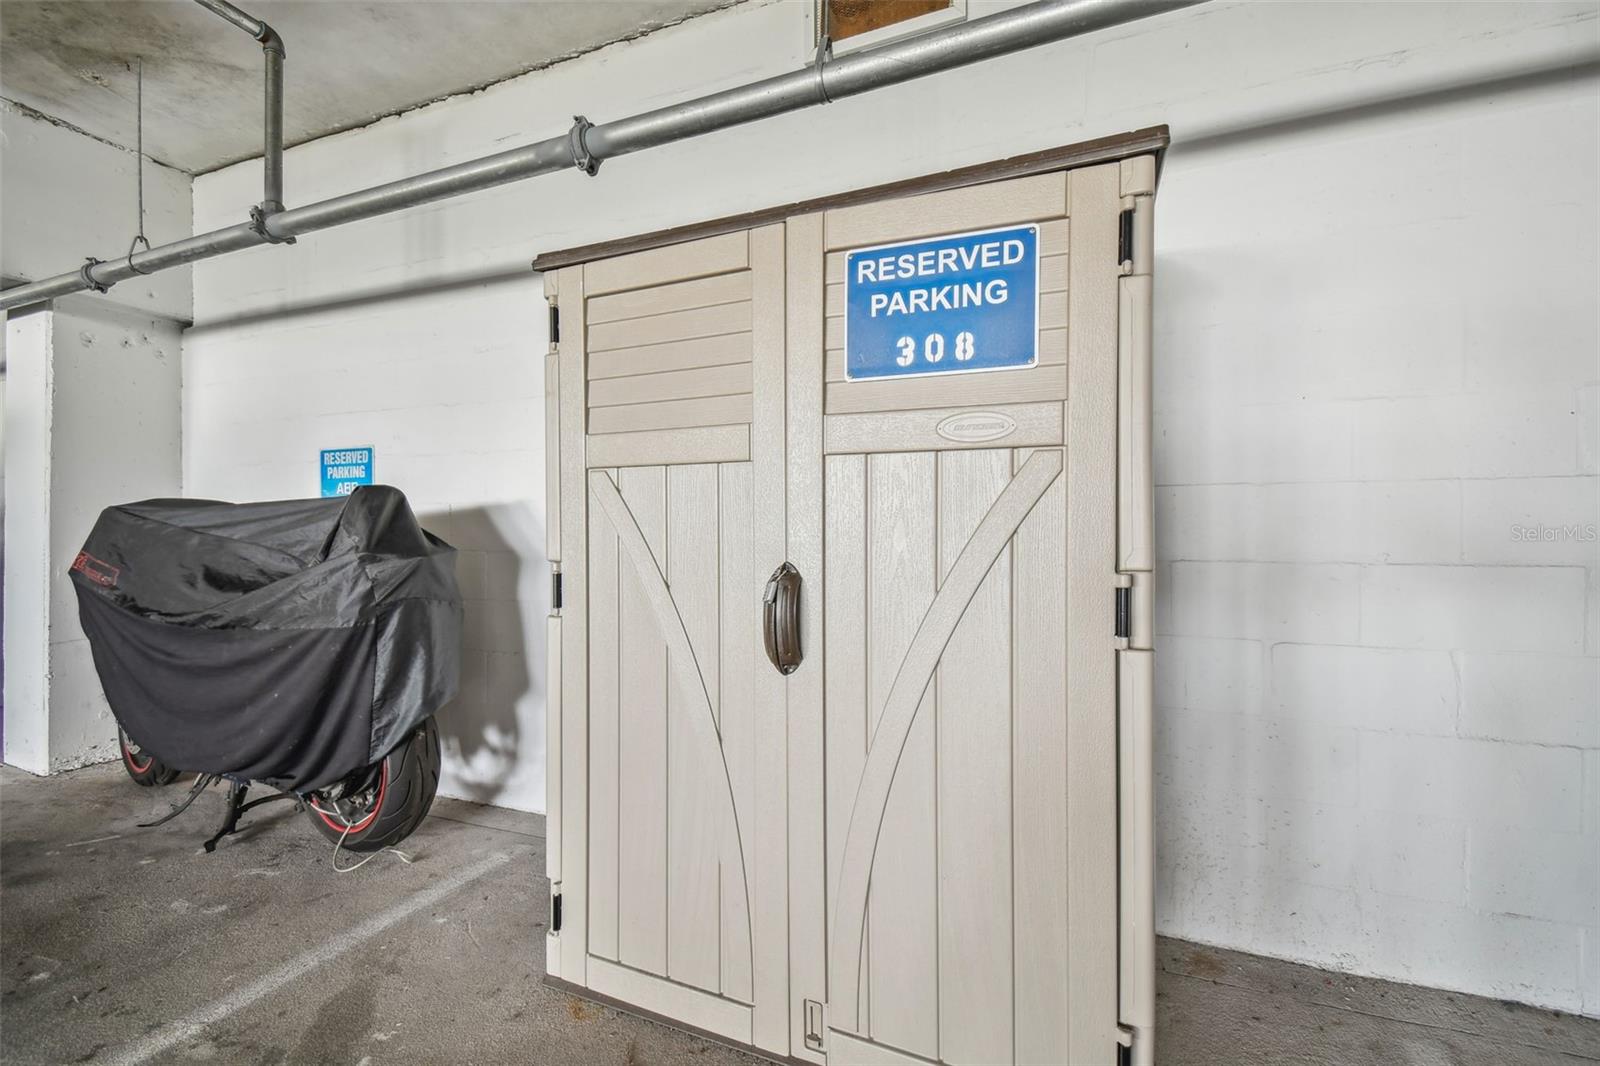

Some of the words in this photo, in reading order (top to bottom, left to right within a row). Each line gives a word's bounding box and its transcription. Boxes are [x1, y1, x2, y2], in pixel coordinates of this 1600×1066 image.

[857, 239, 1025, 284] RESERVED
[870, 279, 1008, 318] PARKING
[896, 331, 975, 367] 308
[324, 450, 369, 465] RESERVED
[327, 465, 366, 479] PARKING
